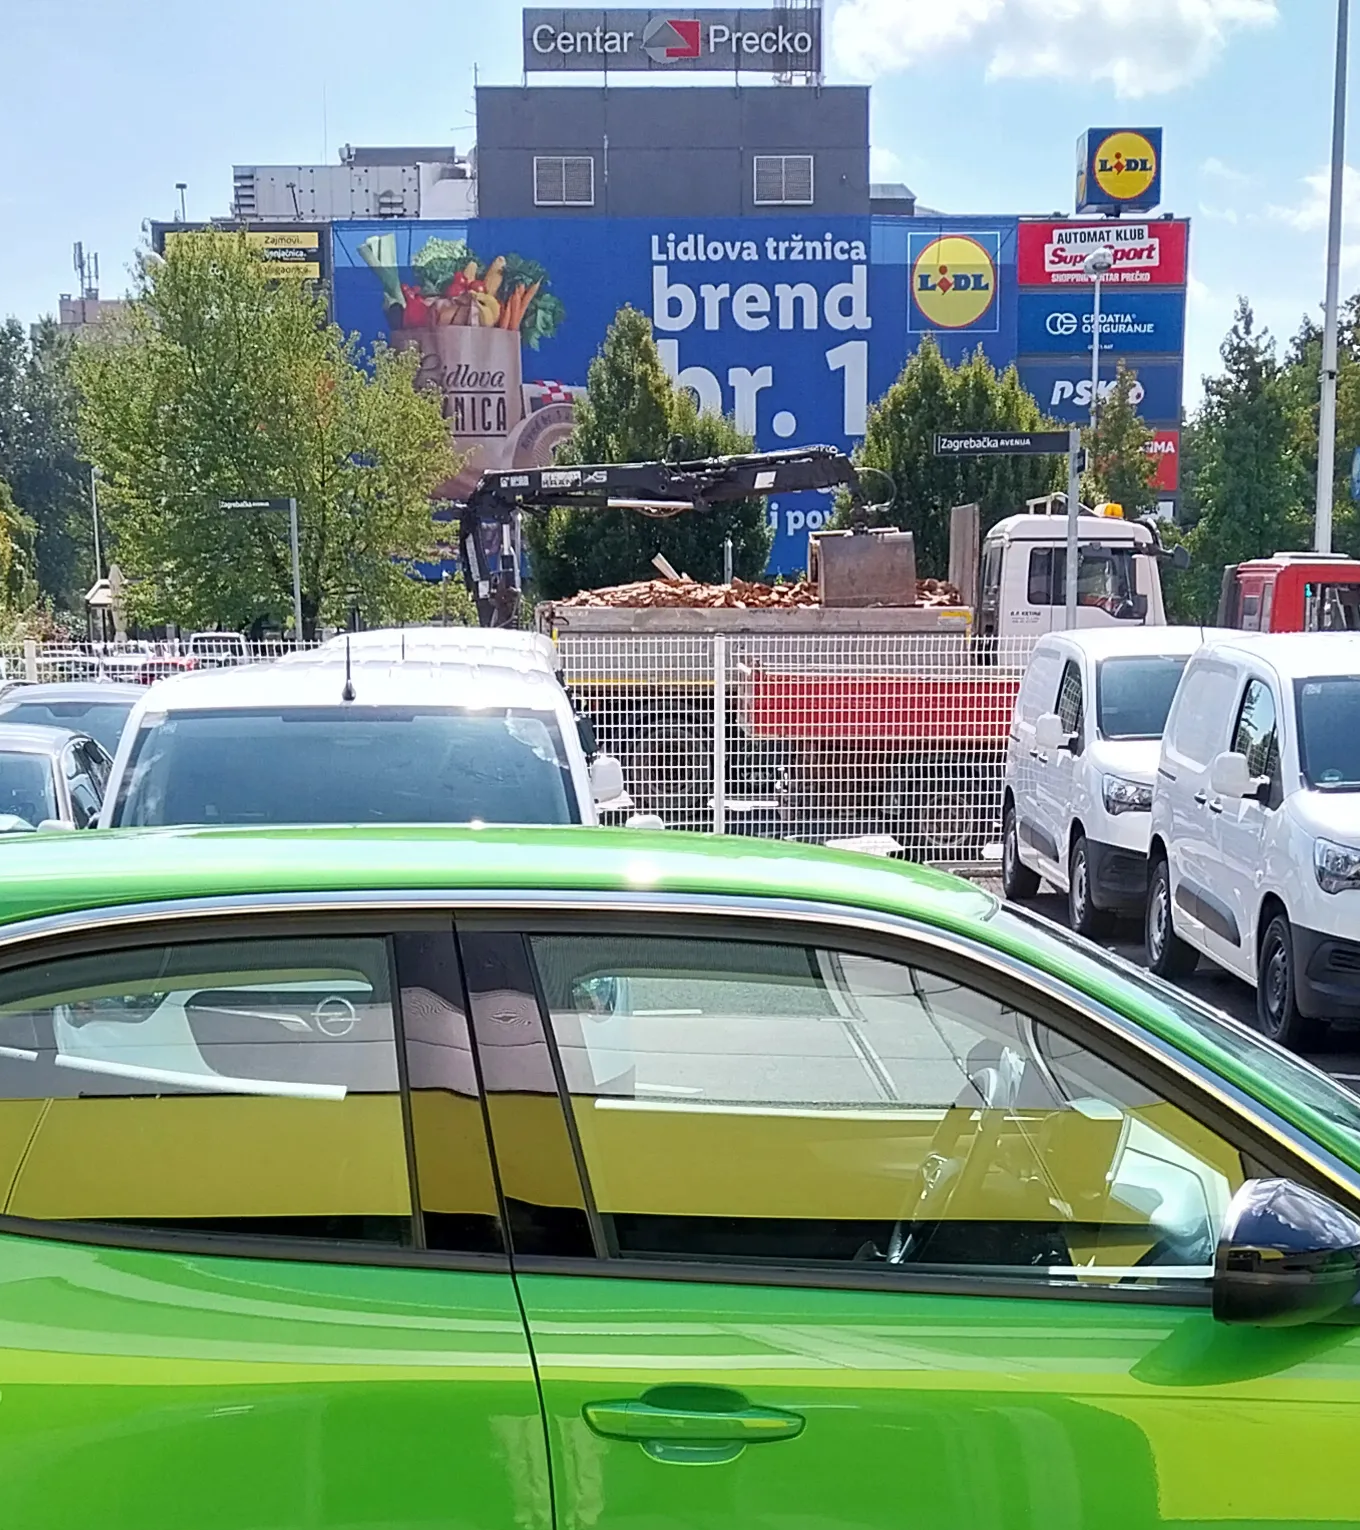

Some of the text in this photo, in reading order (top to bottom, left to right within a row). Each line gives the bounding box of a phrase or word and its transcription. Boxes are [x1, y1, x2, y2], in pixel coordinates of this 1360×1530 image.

[532, 24, 812, 53] Centar Precko
[1098, 152, 1152, 175] LIDL
[651, 232, 867, 261] Lidlova tržnica
[1057, 228, 1145, 244] AUTOMAT KLUB
[918, 265, 990, 296] LIDL
[653, 264, 872, 331] brend
[656, 339, 868, 438] br. 1
[941, 437, 998, 451] Zagrebačka
